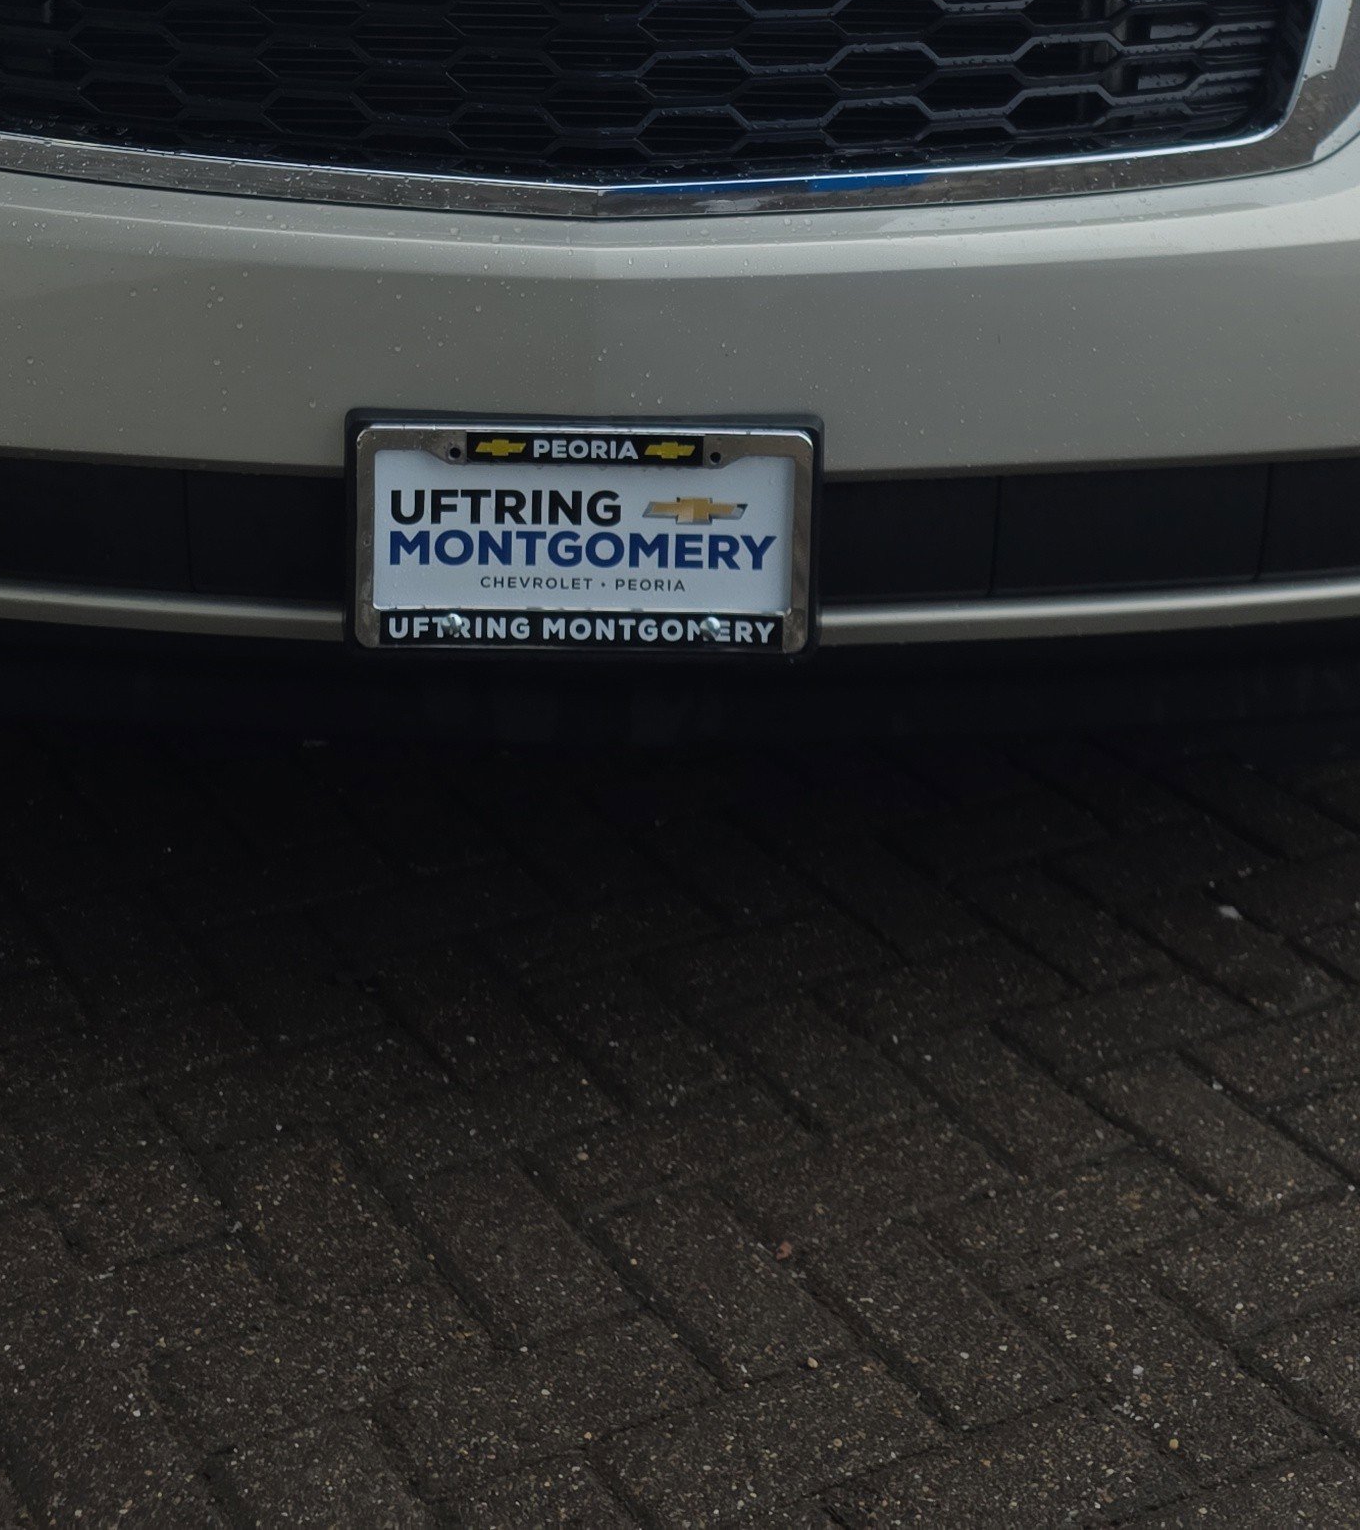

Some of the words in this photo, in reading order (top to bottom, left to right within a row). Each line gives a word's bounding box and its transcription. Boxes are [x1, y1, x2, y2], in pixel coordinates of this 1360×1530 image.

[533, 439, 639, 460] PEORIA
[390, 489, 622, 526] UFTRING
[389, 529, 777, 571] MONTGOMERY
[480, 576, 593, 591] CHEVROLET
[614, 578, 686, 592] PEORIA
